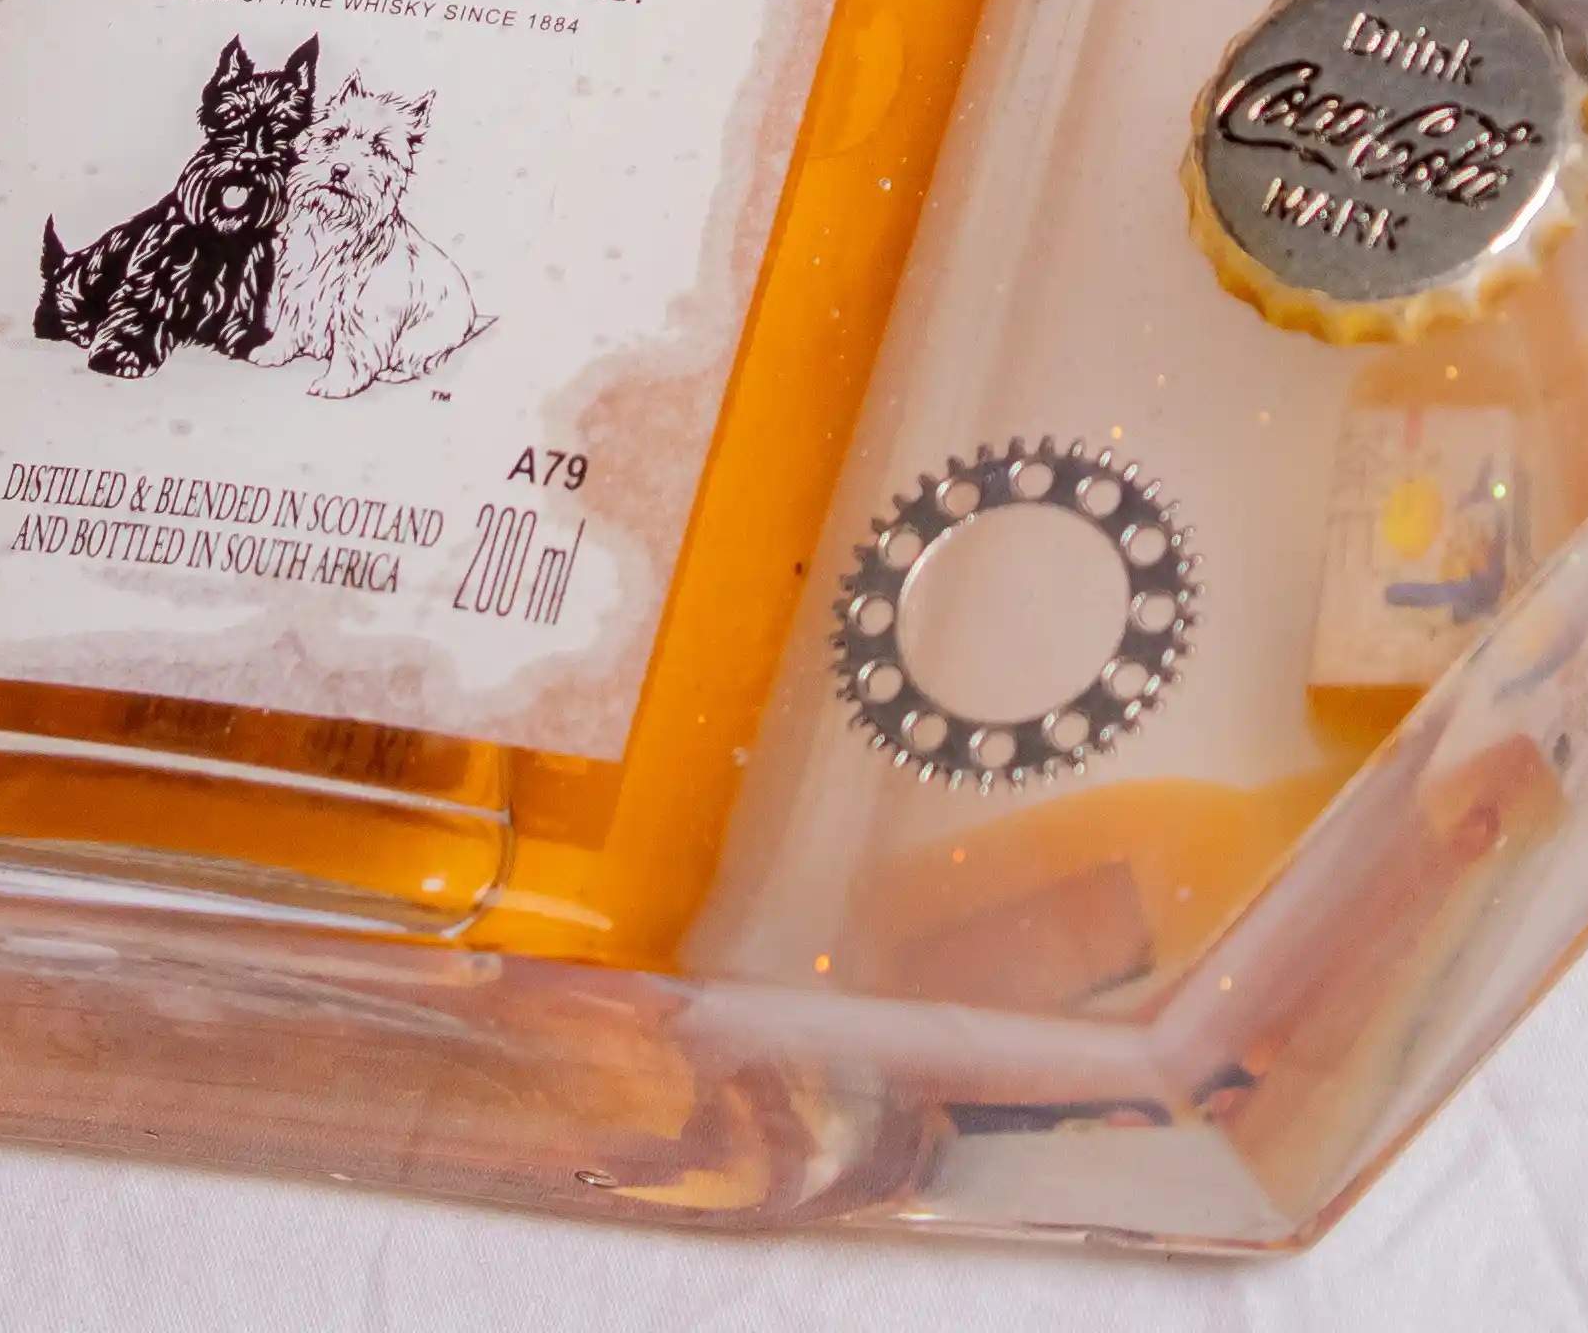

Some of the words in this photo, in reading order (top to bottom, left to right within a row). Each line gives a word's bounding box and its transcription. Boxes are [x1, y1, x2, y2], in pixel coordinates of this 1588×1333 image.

[443, 3, 518, 28] SINCE
[528, 14, 581, 35] 1884
[1341, 10, 1486, 88] Drink
[1261, 175, 1408, 253] MARK
[1, 462, 127, 510] DISTILLED
[129, 475, 153, 513] &
[154, 475, 272, 526] BLENDED
[272, 488, 309, 529] IN
[306, 492, 445, 548] SCOTLAND
[506, 445, 590, 492] A79
[10, 513, 69, 556] AND
[68, 517, 186, 566] BOTTLED
[186, 529, 220, 570] IN
[220, 532, 314, 582] SOUTH
[311, 545, 402, 594] AFRICA
[452, 502, 538, 618] 200
[524, 517, 587, 626] ml
